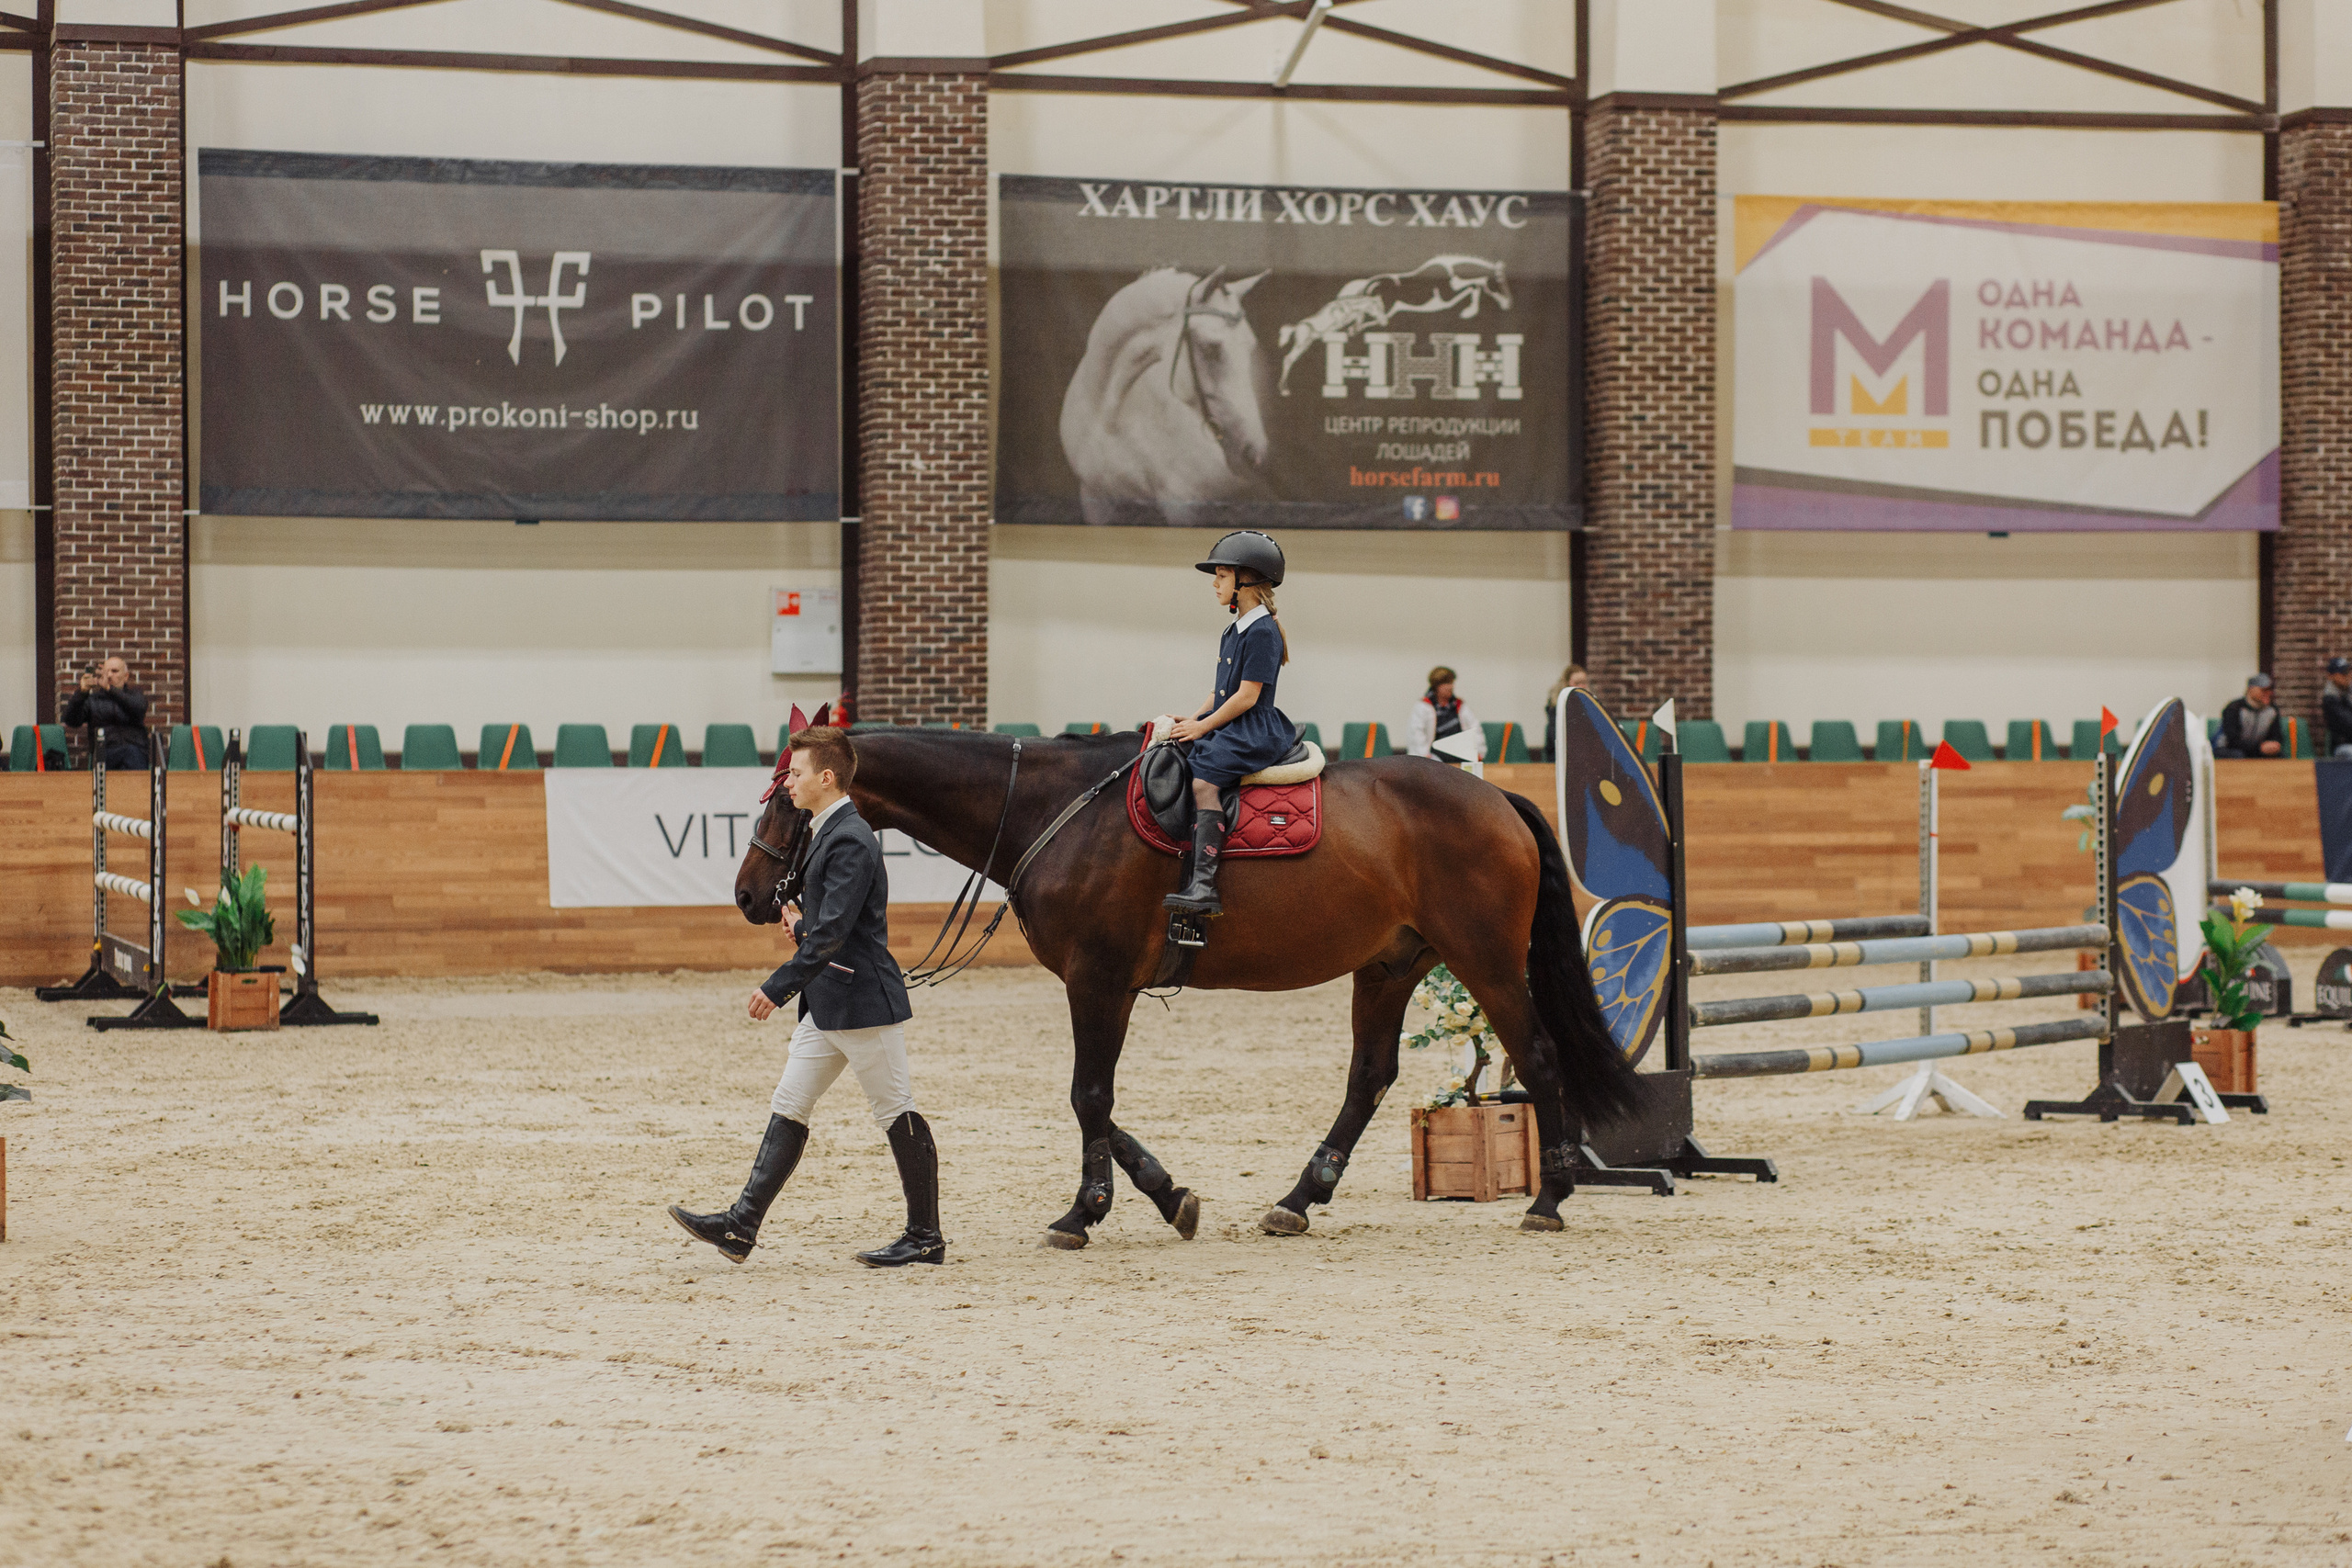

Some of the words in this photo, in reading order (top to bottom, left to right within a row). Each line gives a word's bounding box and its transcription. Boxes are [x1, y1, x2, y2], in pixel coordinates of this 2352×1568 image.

[1078, 184, 1264, 222] ХАРТЛИ
[1274, 191, 1396, 227] ХОРС
[1406, 193, 1530, 230] ХАУС
[219, 279, 441, 324] HORSE
[631, 292, 814, 332] PILOT
[1977, 279, 2083, 310] ОДНА
[1979, 318, 2192, 355] КОМАНДА
[1977, 369, 2083, 400] ОДНА
[359, 401, 700, 435] www.prokoni-shop.ru
[1324, 415, 1383, 434] ЦЕНТР
[1388, 417, 1522, 437] РЕПРОДУКЦИИ
[1980, 409, 2210, 454] ПОБЕДА!
[1376, 440, 1470, 463] ЛОШАДЕЙ
[1351, 466, 1500, 487] horsefarm.ru
